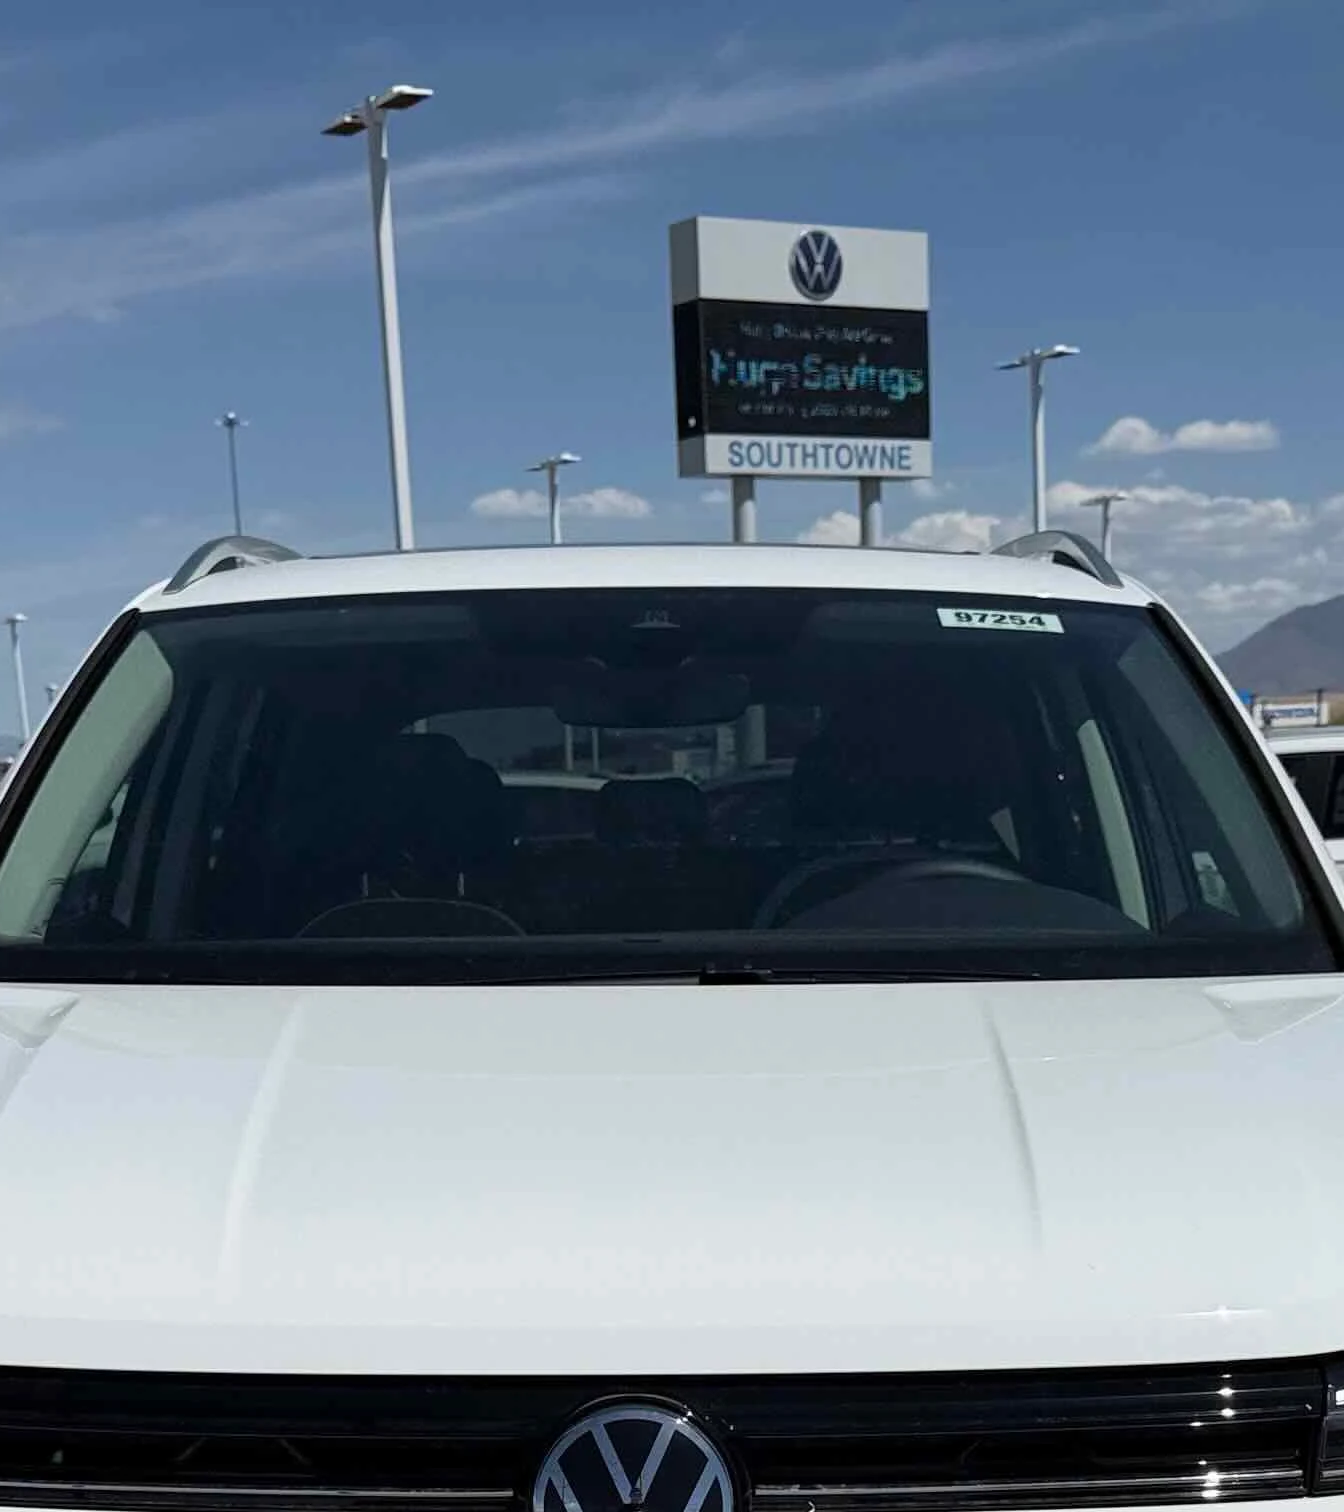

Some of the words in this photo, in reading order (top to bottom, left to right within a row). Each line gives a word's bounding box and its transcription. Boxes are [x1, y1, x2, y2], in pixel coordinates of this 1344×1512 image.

[802, 353, 924, 402] Savings
[728, 441, 912, 471] SOUTHTOWNE
[954, 611, 1046, 627] 97254
